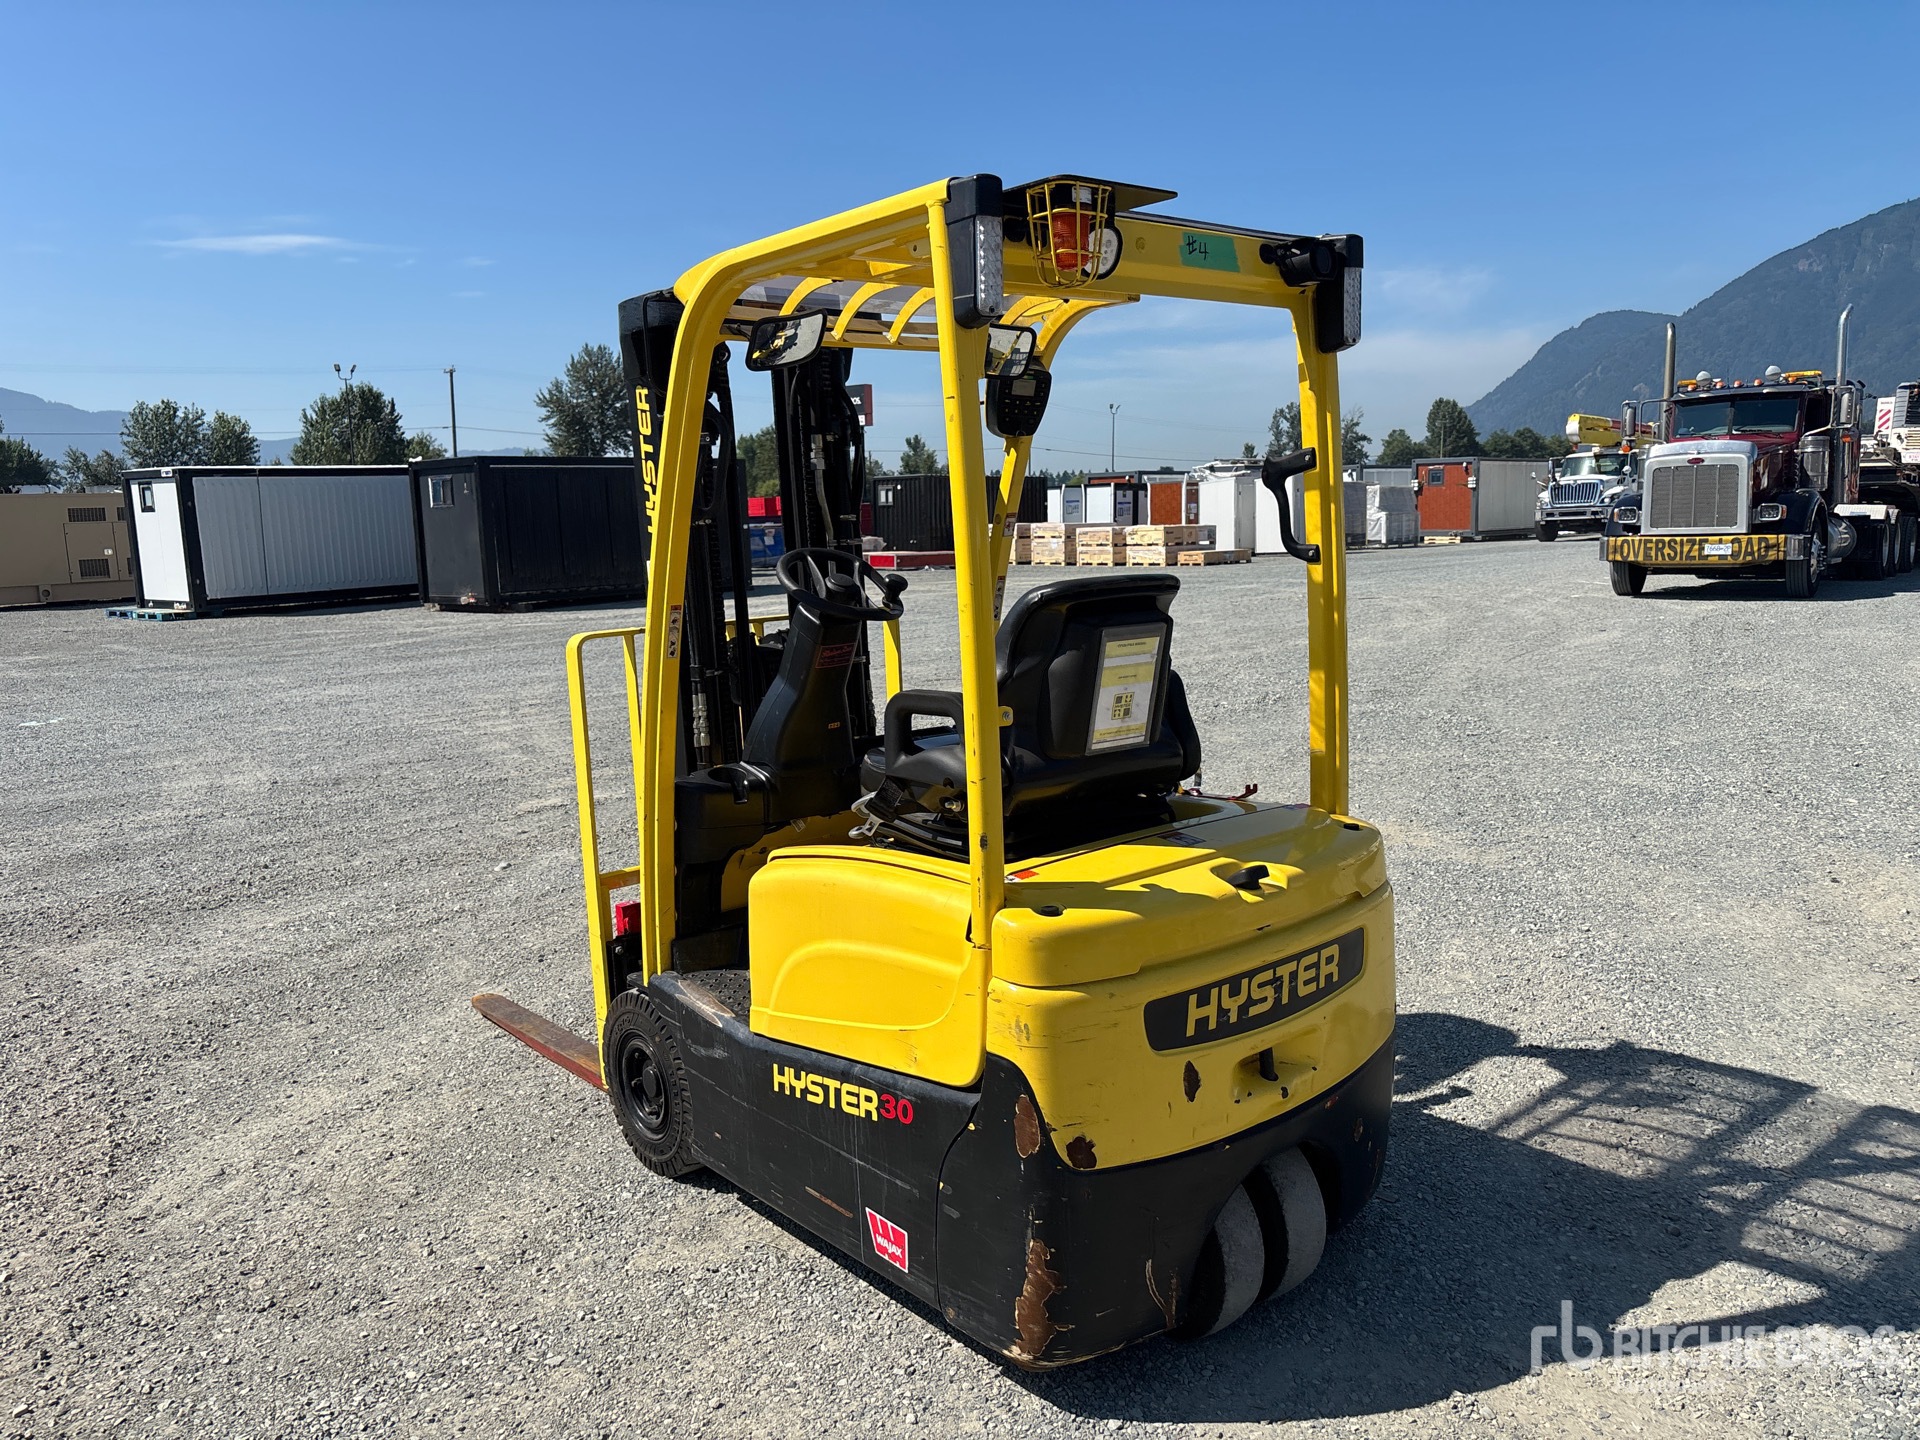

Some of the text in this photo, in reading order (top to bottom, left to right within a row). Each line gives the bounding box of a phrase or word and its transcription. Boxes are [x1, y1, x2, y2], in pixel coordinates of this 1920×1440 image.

[1619, 536, 1770, 562] OVERSIZE LOAD
[1185, 943, 1340, 1038] HYSTER
[876, 1233, 902, 1259] WAJAX
